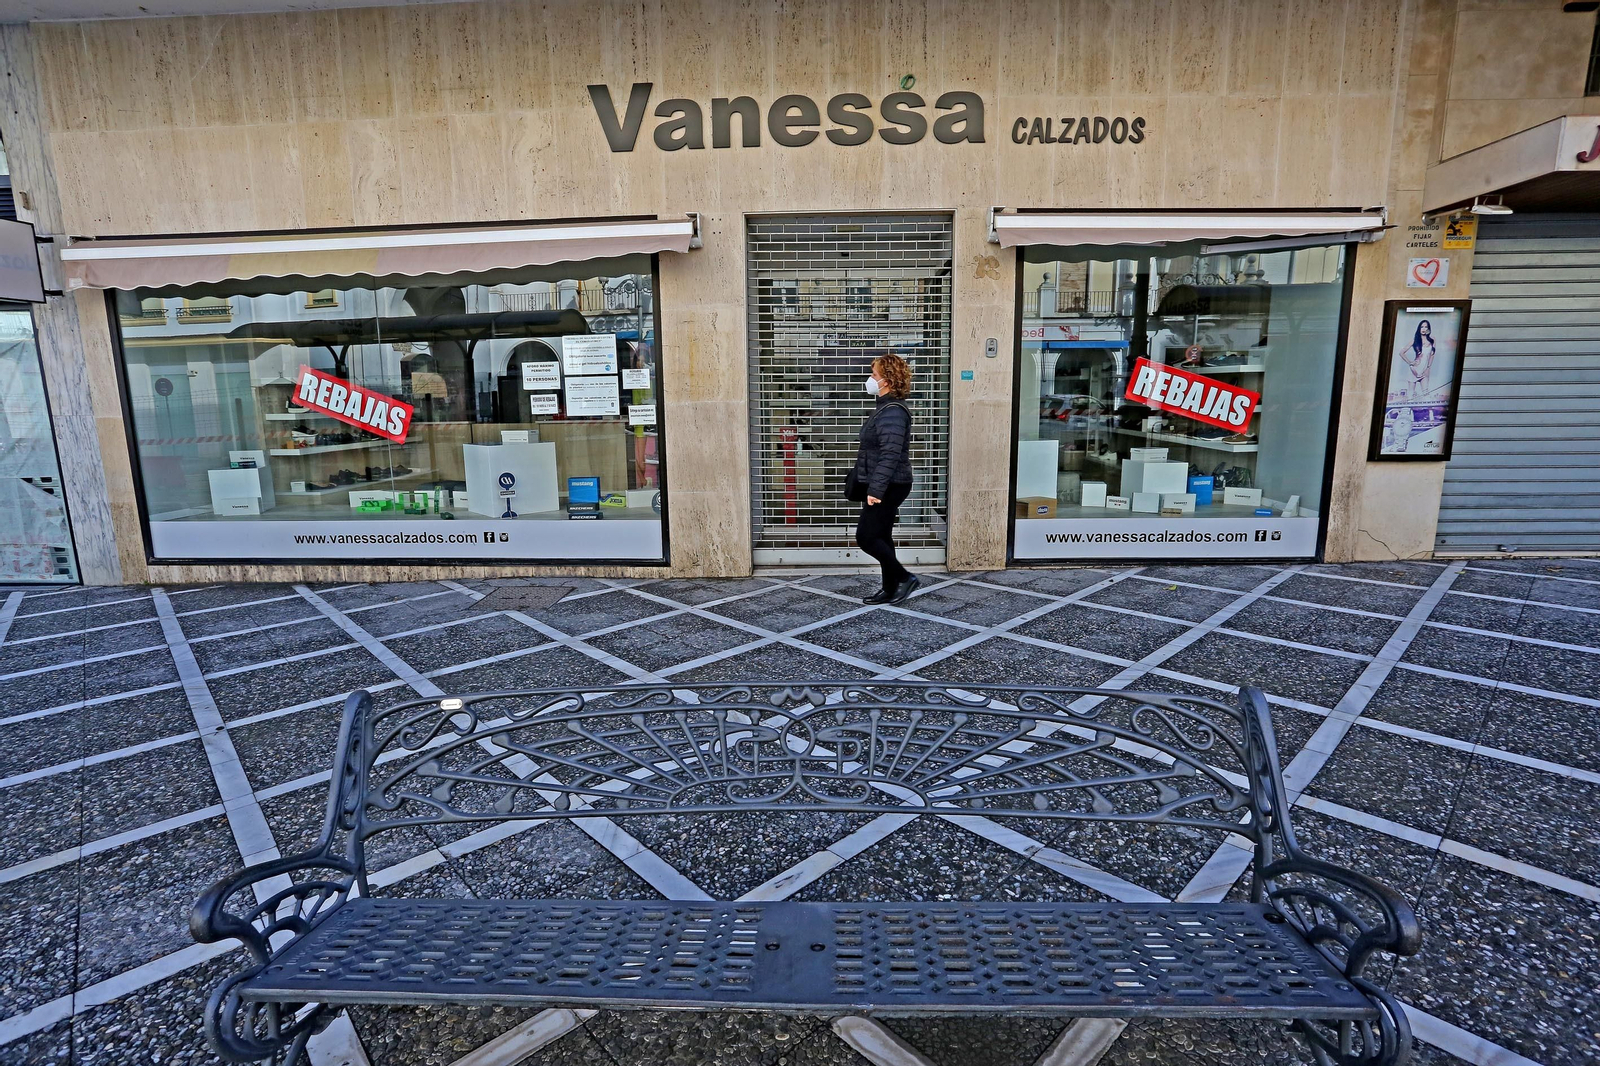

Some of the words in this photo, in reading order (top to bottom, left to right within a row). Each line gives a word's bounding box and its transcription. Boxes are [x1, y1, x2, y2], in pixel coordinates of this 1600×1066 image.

[587, 82, 985, 152] Vanessa
[1011, 116, 1146, 145] CALZADOS
[299, 372, 406, 436] REBAJAS
[1132, 365, 1251, 426] REBAJAS
[294, 532, 477, 544] www.vanessacalzados.com
[1045, 529, 1248, 544] www.vanessacalzados.com
